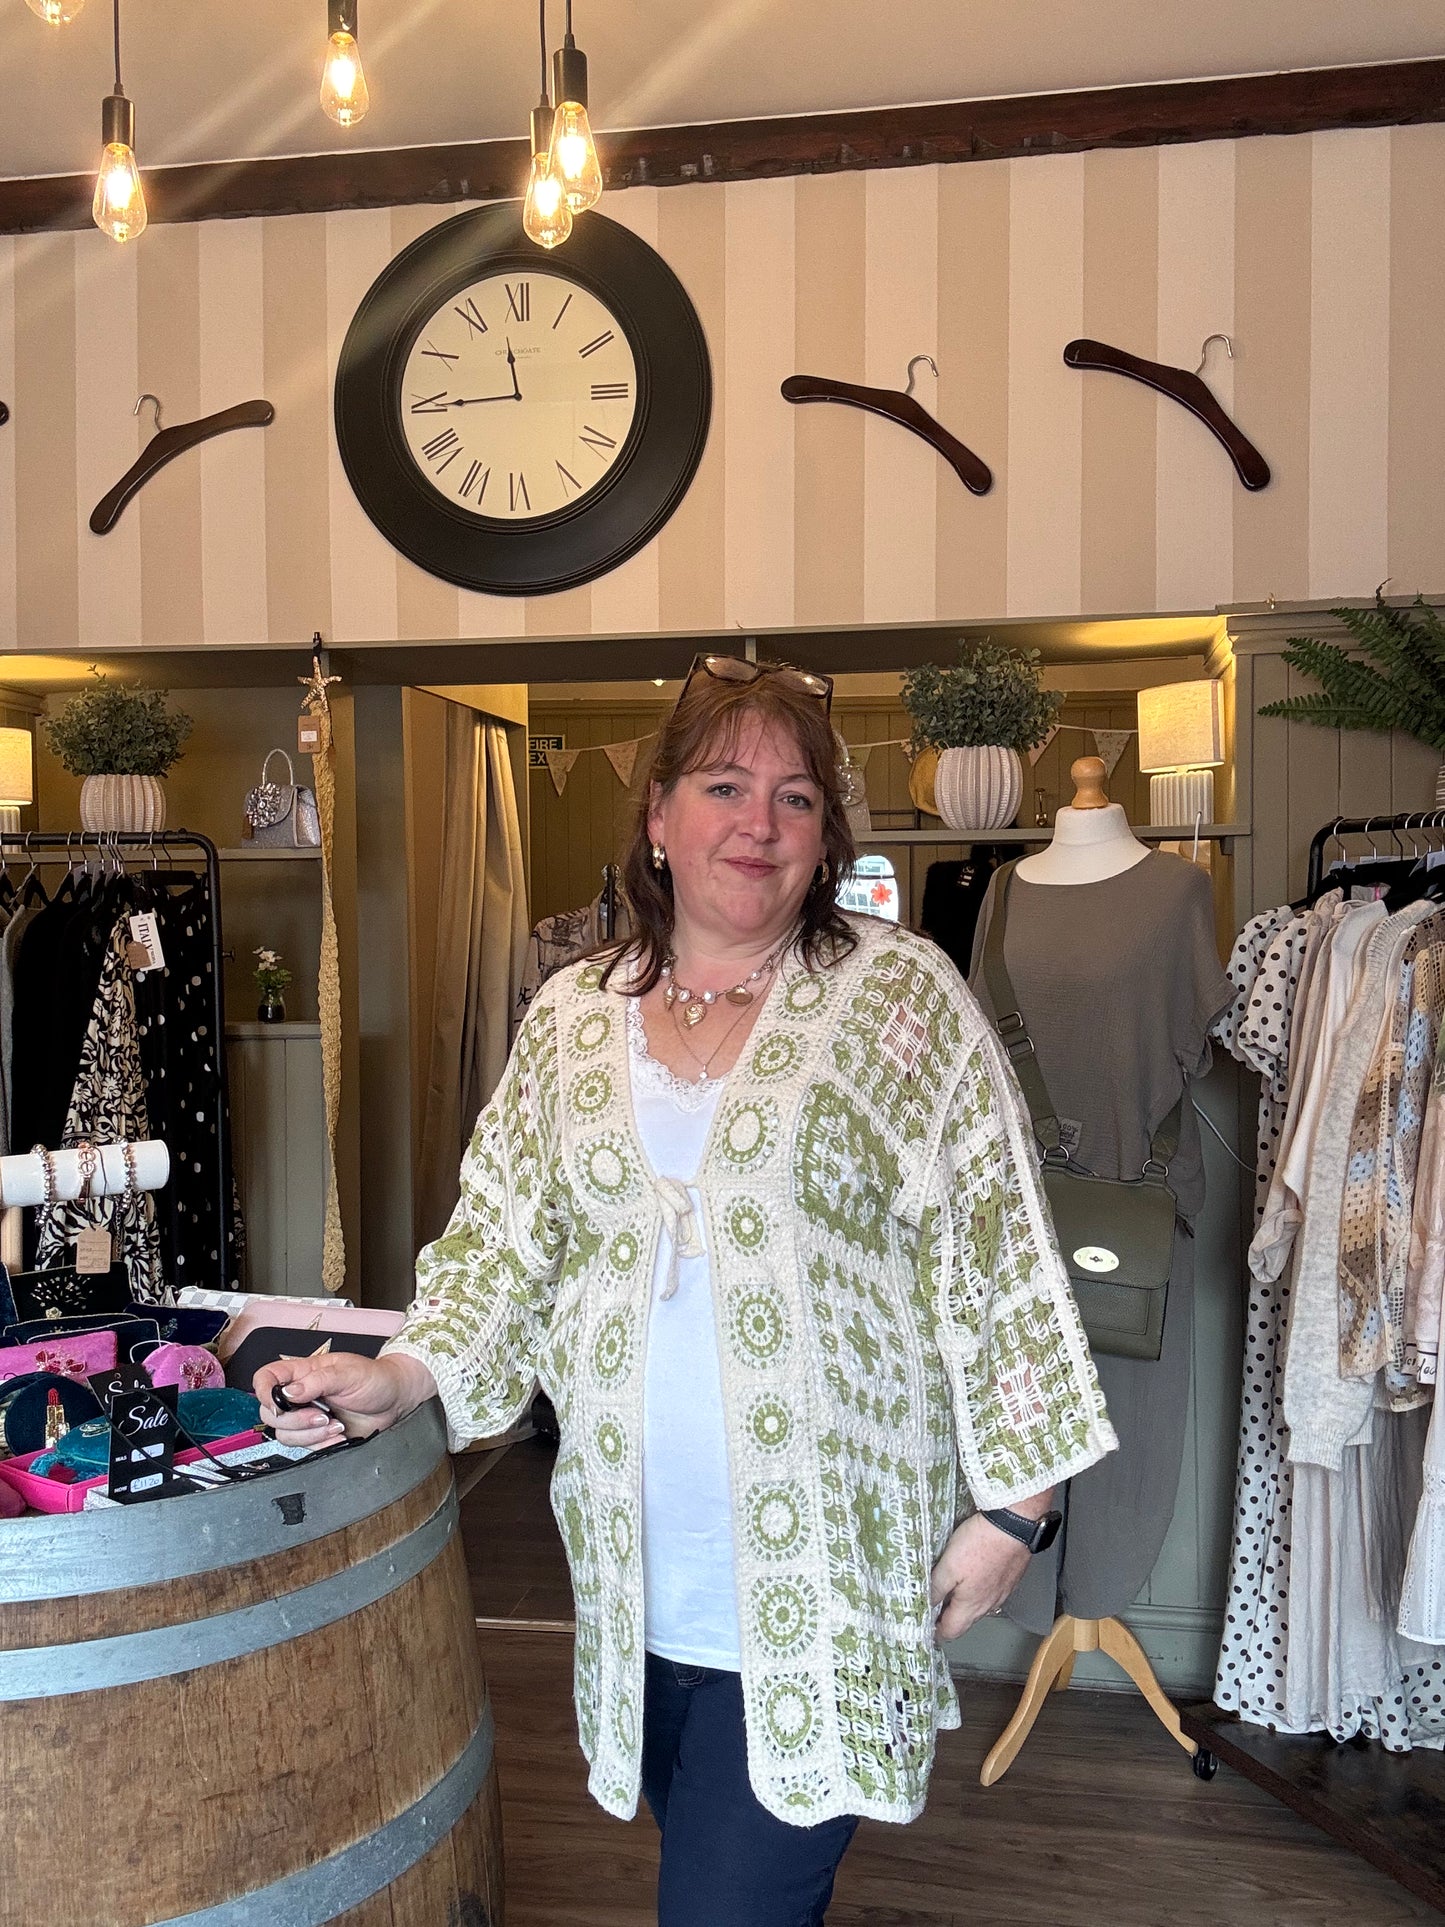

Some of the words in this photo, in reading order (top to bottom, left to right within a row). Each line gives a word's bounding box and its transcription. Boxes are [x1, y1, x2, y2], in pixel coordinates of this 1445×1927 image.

[454, 297, 488, 341] XI
[505, 282, 530, 323] XII
[552, 293, 573, 330] I
[421, 339, 459, 371] X
[578, 329, 615, 359] II
[410, 391, 448, 414] IX
[590, 382, 629, 401] III
[421, 427, 465, 476] VIII
[578, 424, 617, 463] IV
[458, 459, 491, 506] VII
[509, 471, 531, 512] VI
[555, 459, 582, 498] V
[529, 738, 558, 750] FIRE
[529, 752, 546, 764] EX
[118, 1405, 169, 1437] Sale
